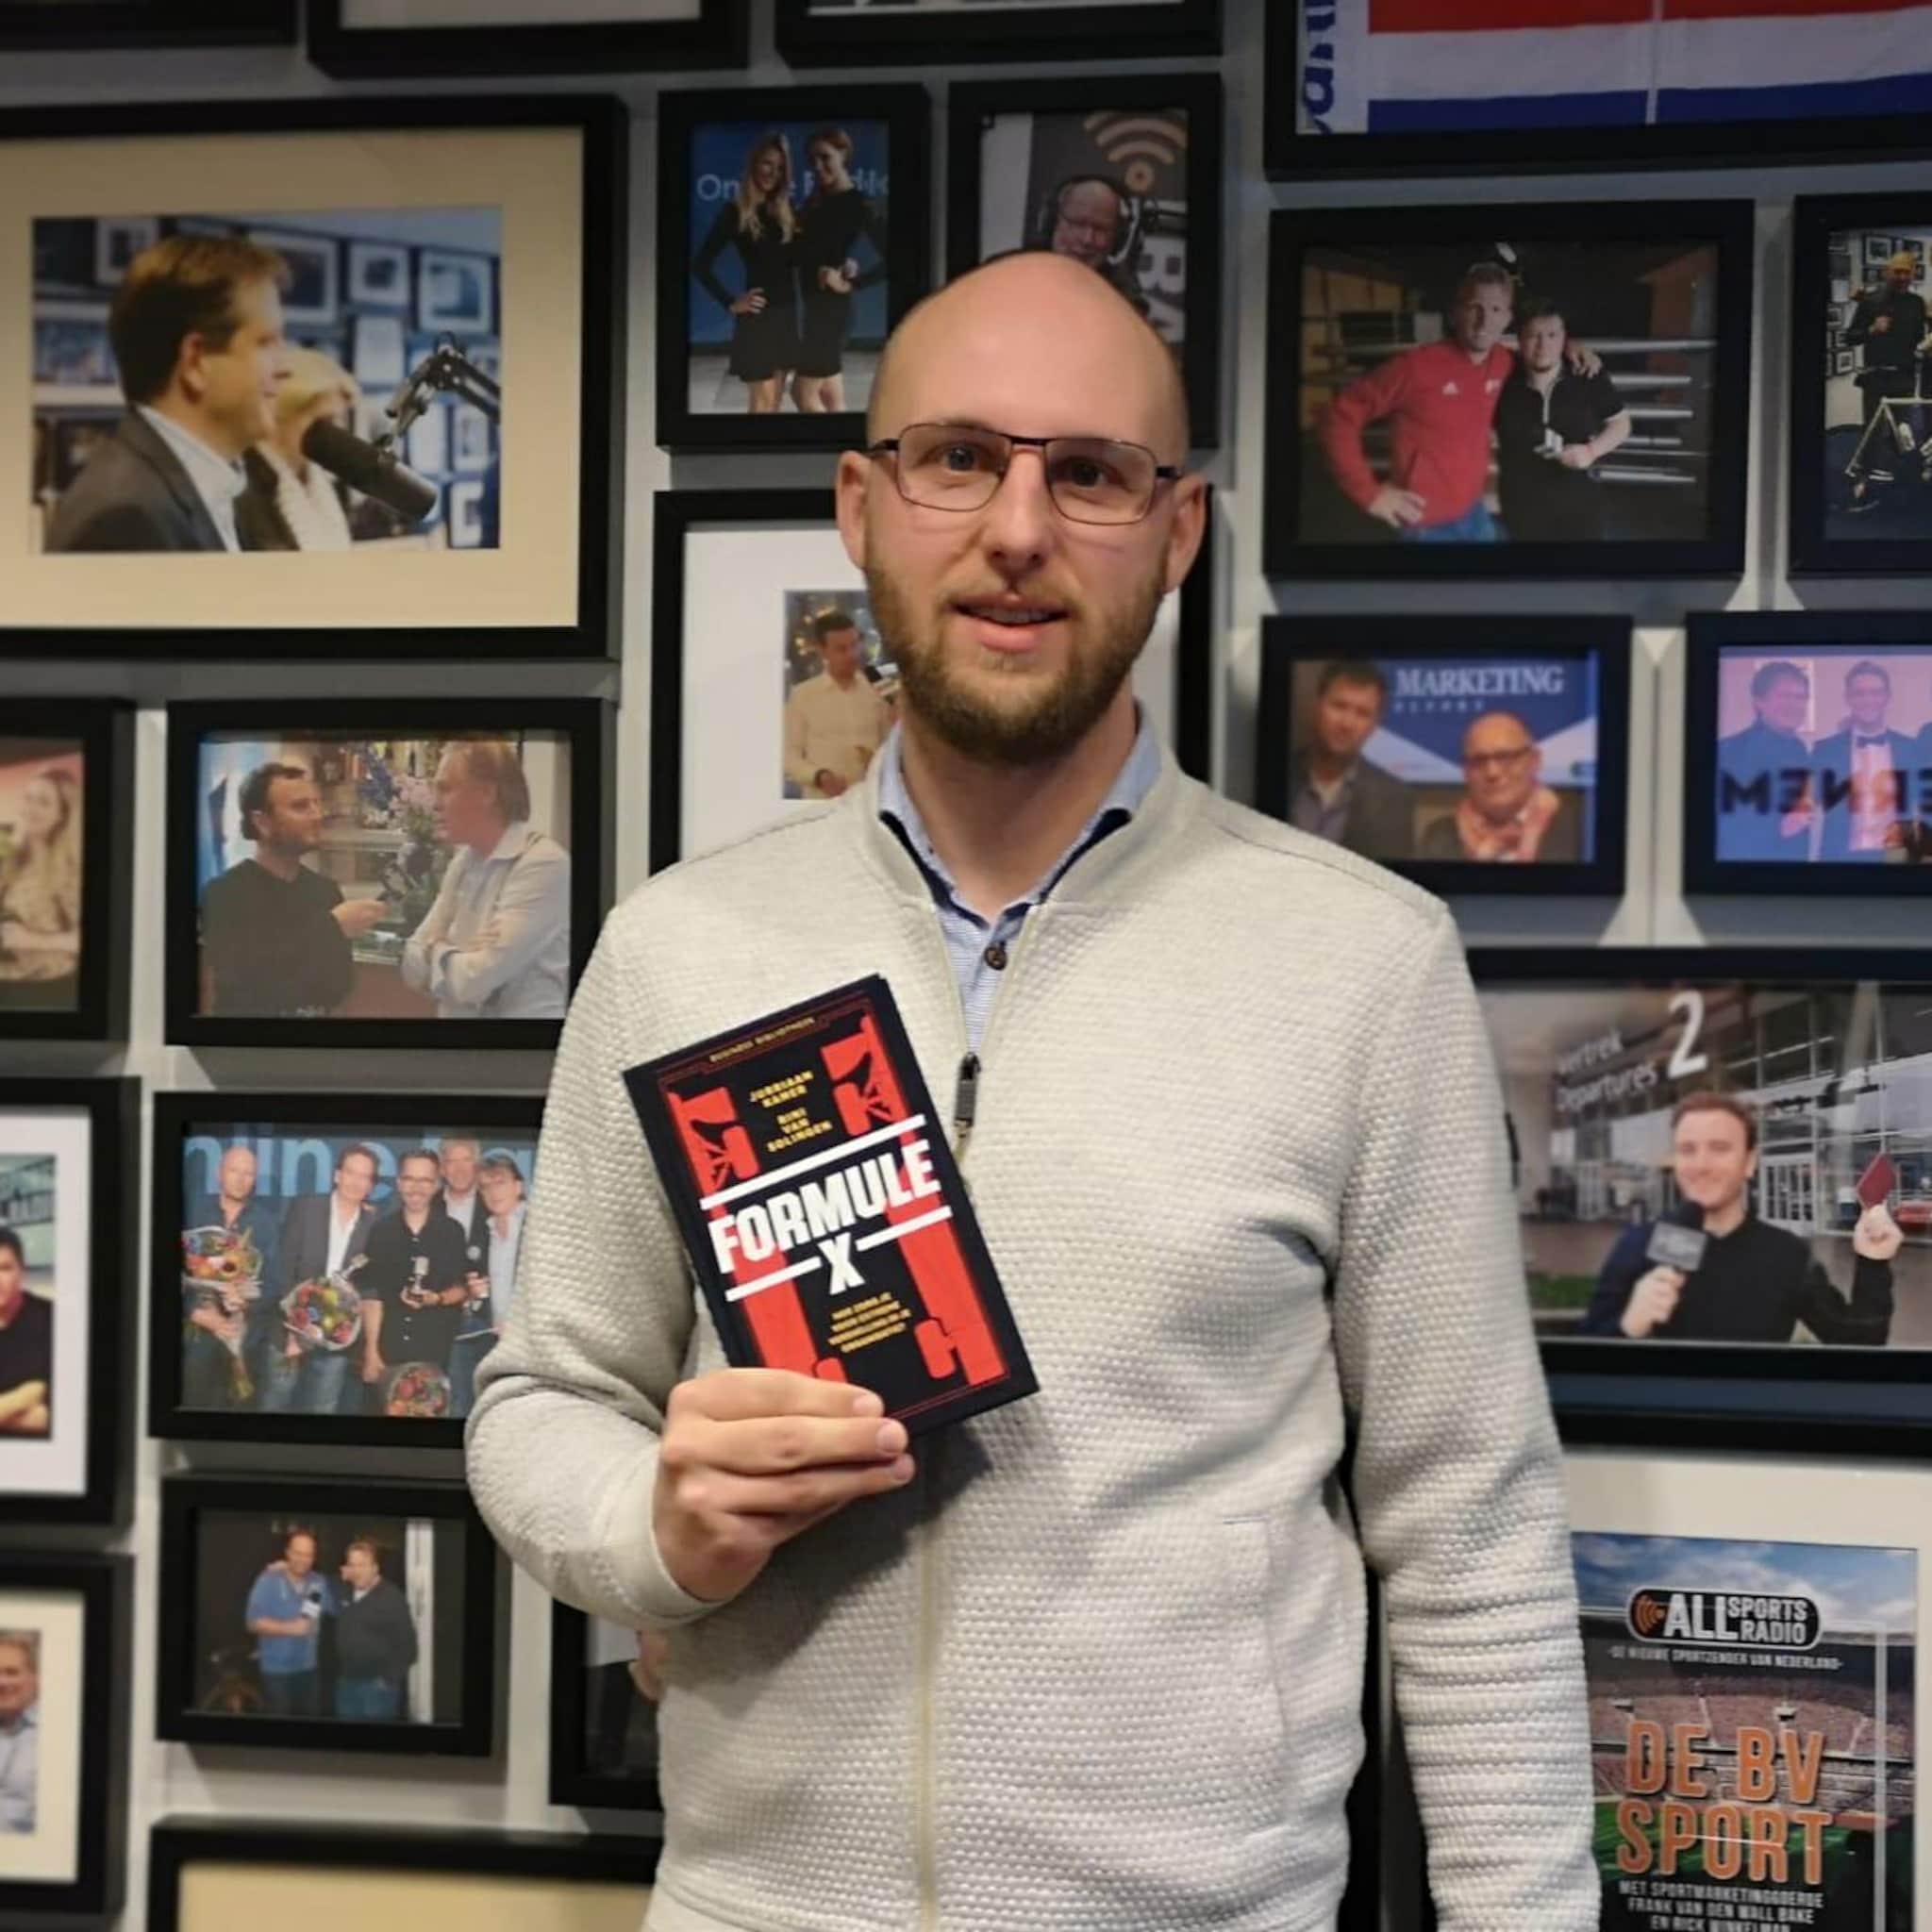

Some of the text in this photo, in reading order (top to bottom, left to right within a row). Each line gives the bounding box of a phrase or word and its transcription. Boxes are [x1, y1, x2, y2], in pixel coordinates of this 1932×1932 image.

[1395, 665, 1564, 697] MARKETING
[1668, 991, 1708, 1078] 2
[708, 1140, 941, 1274] FORMULE
[816, 1233, 865, 1295] X
[1663, 1592, 1807, 1641] ALL SPORTS
[1740, 1620, 1807, 1644] RADIO
[1624, 1720, 1824, 1806] DE BV
[1616, 1796, 1833, 1885] SPORT
[1619, 1880, 1646, 1896] MET
[1627, 1897, 1815, 1924] FRANK VAN DEN WALL BAKE
[1651, 1915, 1669, 1930] EN
